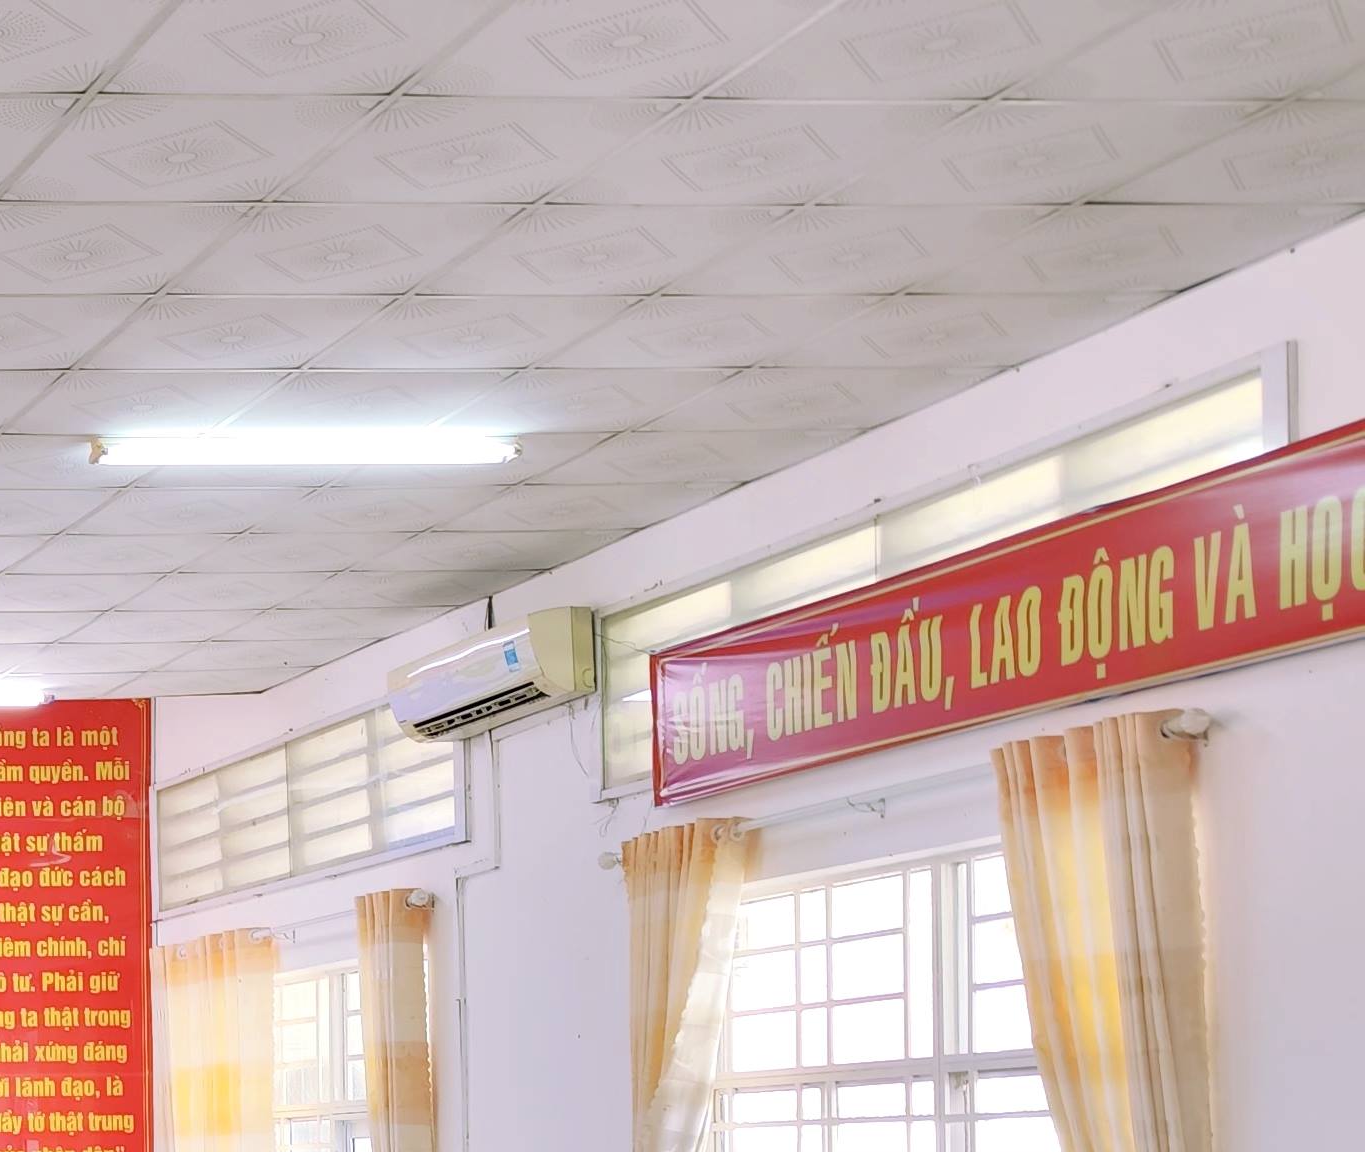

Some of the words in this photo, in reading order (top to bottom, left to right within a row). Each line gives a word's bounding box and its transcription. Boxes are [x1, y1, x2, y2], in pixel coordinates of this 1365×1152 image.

[766, 623, 858, 740] CHIẾN
[870, 597, 955, 710] ĐẤU,
[969, 585, 1042, 690] LAO
[1057, 545, 1174, 680] ĐỘNG
[1194, 504, 1257, 630] VÀ
[32, 728, 50, 746] ta
[57, 727, 74, 746] là
[82, 726, 118, 750] một
[29, 759, 89, 785] quyền.
[96, 758, 130, 781] Mỗi
[32, 796, 54, 817] và
[61, 796, 97, 817] cán
[102, 795, 126, 820] bộ
[26, 832, 51, 857] sự
[53, 829, 103, 852] thấm
